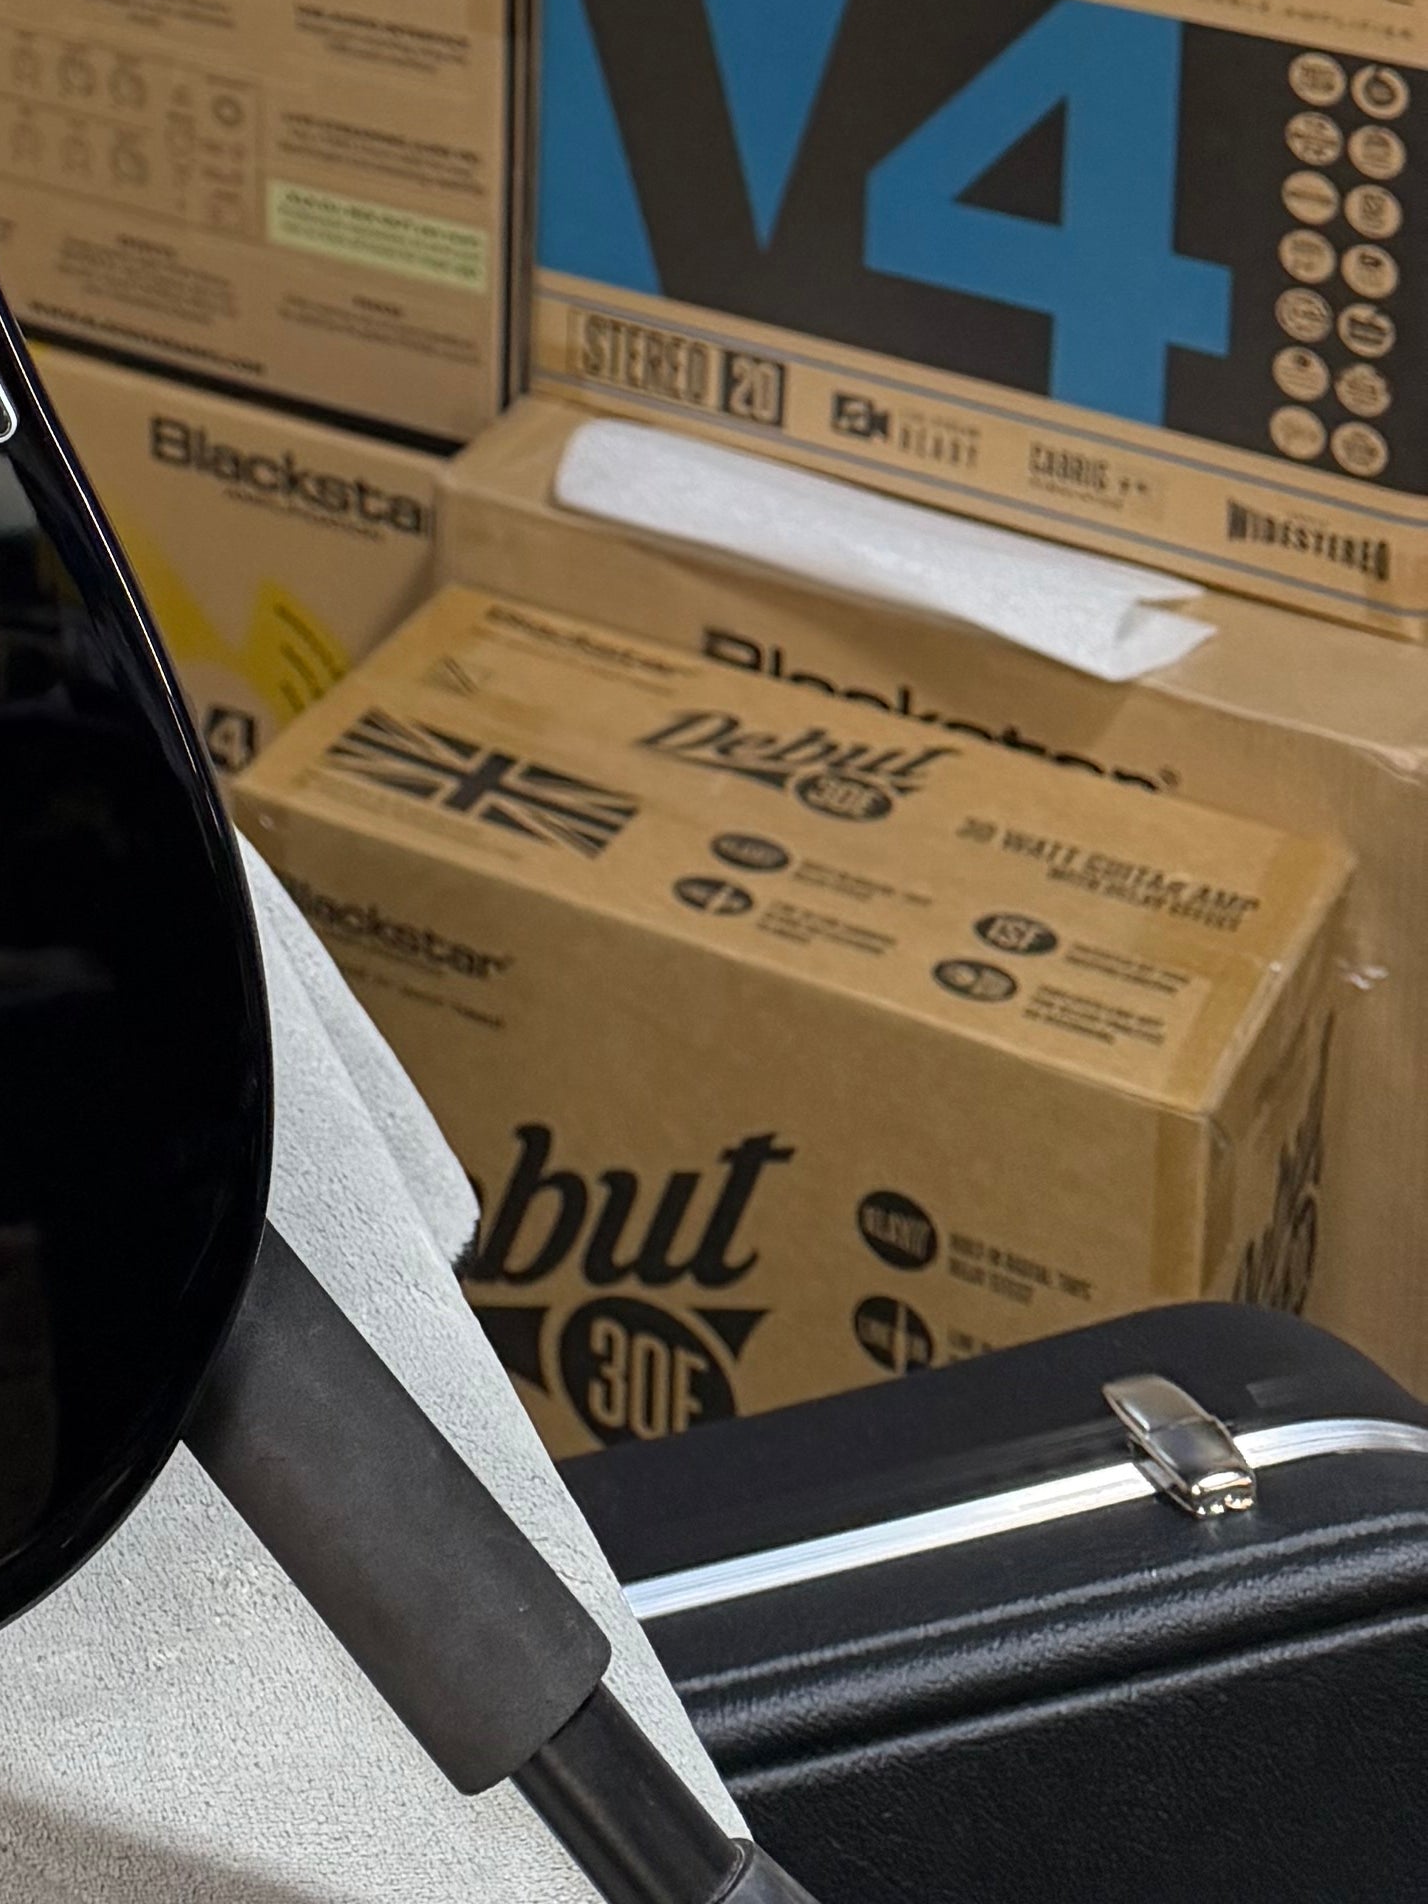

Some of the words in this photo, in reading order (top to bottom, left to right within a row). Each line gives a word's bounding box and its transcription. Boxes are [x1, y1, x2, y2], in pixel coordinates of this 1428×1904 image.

[582, 312, 711, 408] STEREO
[637, 709, 961, 780] Debut
[460, 1122, 799, 1290] but
